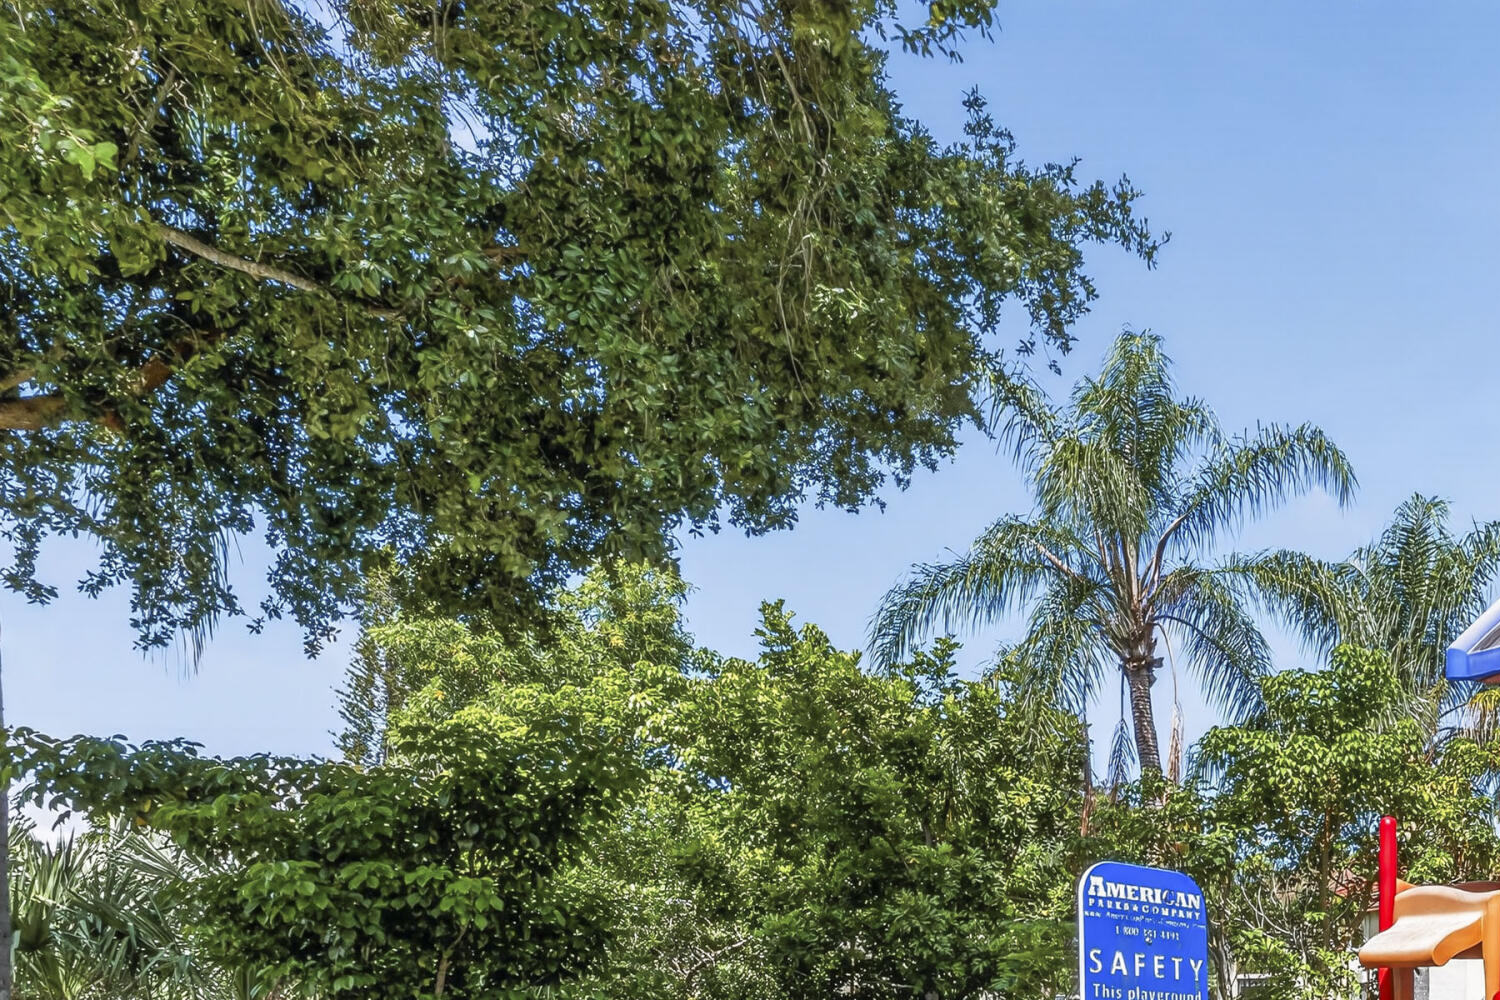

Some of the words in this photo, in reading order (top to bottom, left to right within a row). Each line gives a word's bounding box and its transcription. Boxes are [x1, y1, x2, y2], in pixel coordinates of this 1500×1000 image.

[1088, 875, 1200, 909] AMERICAN
[1141, 905, 1200, 920] COMPANY
[1089, 948, 1203, 981] SAFETY
[1093, 983, 1122, 999] This
